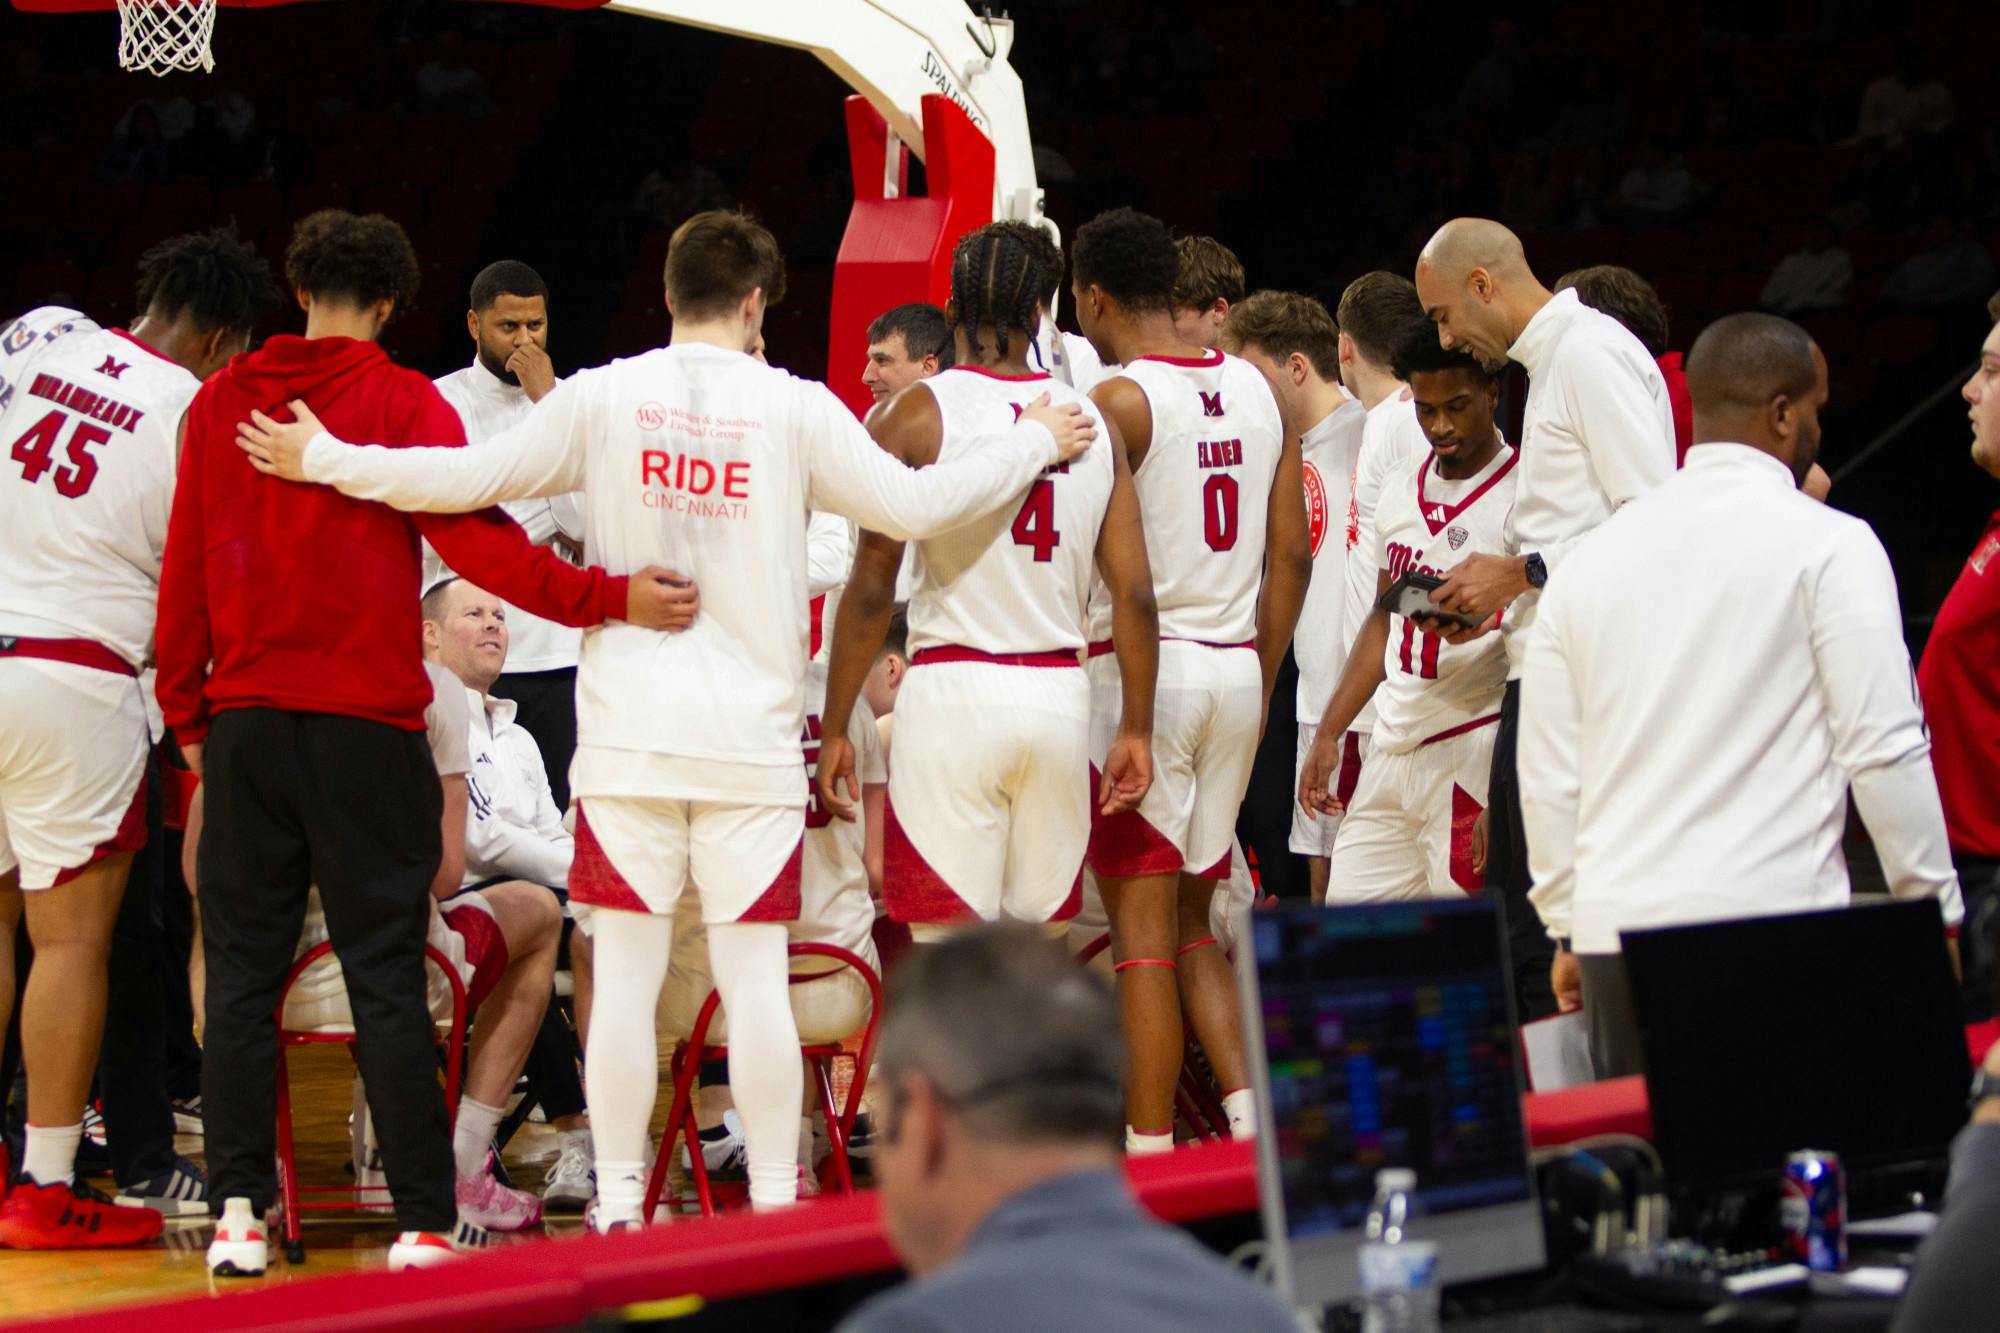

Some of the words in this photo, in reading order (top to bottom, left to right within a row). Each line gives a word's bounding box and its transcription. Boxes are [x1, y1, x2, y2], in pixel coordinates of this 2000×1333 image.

[28, 372, 145, 434] MIRAMBEAUX
[716, 416, 762, 430] Southern
[11, 409, 112, 499] 45
[710, 427, 745, 442] Group
[1197, 438, 1243, 469] ELMER
[641, 449, 751, 500] RIDE
[1306, 473, 1321, 523] HONOR
[1011, 479, 1060, 562] 4
[1203, 473, 1239, 552] 0
